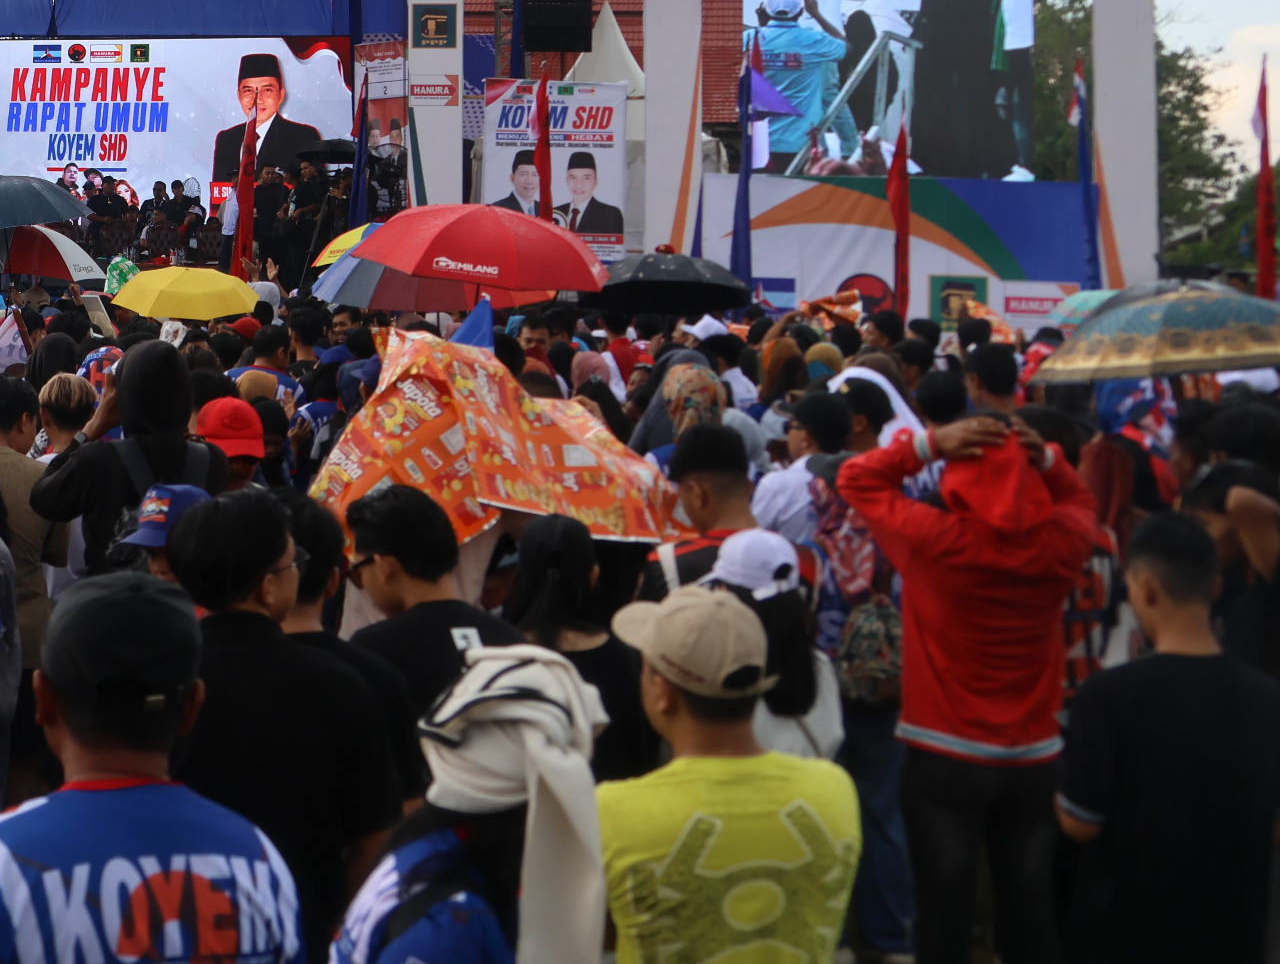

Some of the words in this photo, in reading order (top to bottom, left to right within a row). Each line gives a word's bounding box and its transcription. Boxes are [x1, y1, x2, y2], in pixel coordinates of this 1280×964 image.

[11, 67, 166, 103] KAMPANYE
[413, 86, 450, 94] HANURA
[7, 102, 87, 132] RAPAT
[93, 102, 169, 132] UMUM
[498, 105, 569, 129] KOM
[572, 106, 614, 129] SHD
[47, 134, 95, 161] KOYEM
[99, 133, 128, 161] SHD
[396, 378, 443, 419] Japota
[42, 853, 282, 962] KOYEM
